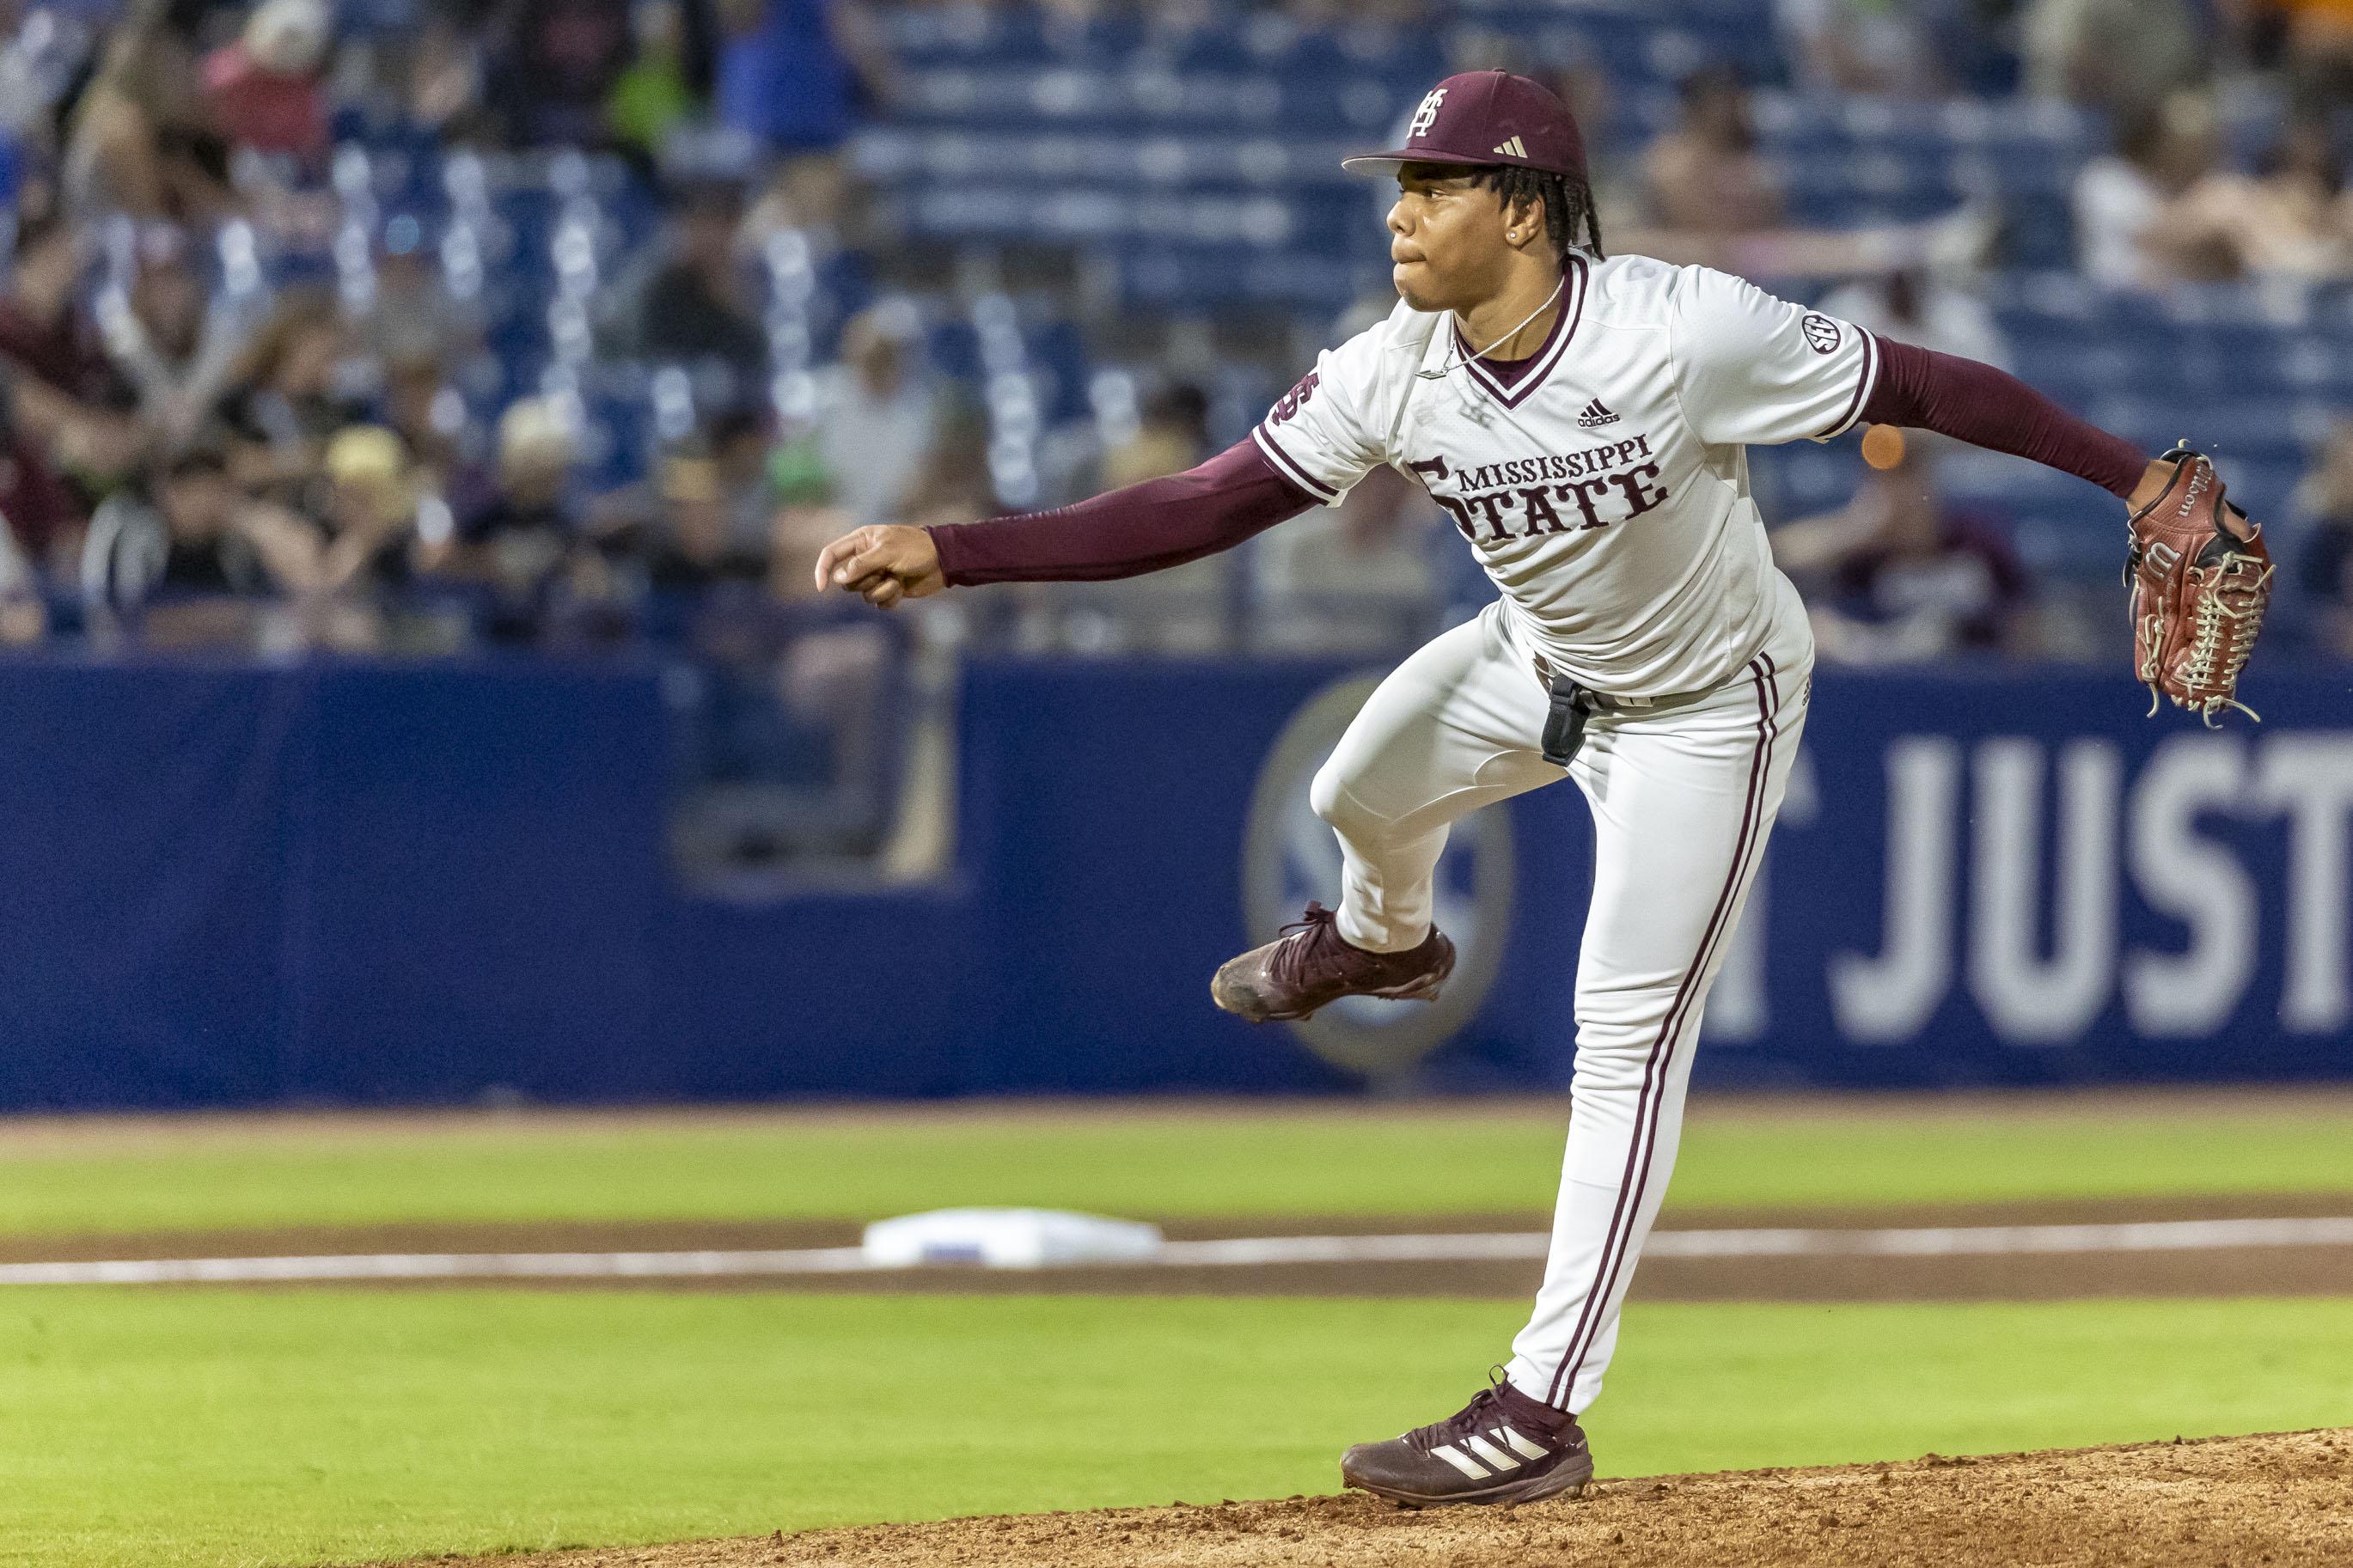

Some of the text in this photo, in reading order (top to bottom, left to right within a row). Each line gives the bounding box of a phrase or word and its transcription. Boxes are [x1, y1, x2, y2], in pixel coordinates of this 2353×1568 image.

[1577, 413, 1621, 428] adidas
[1454, 433, 1653, 492] MISSISSIPPI
[1826, 733, 2353, 1041] JUST
